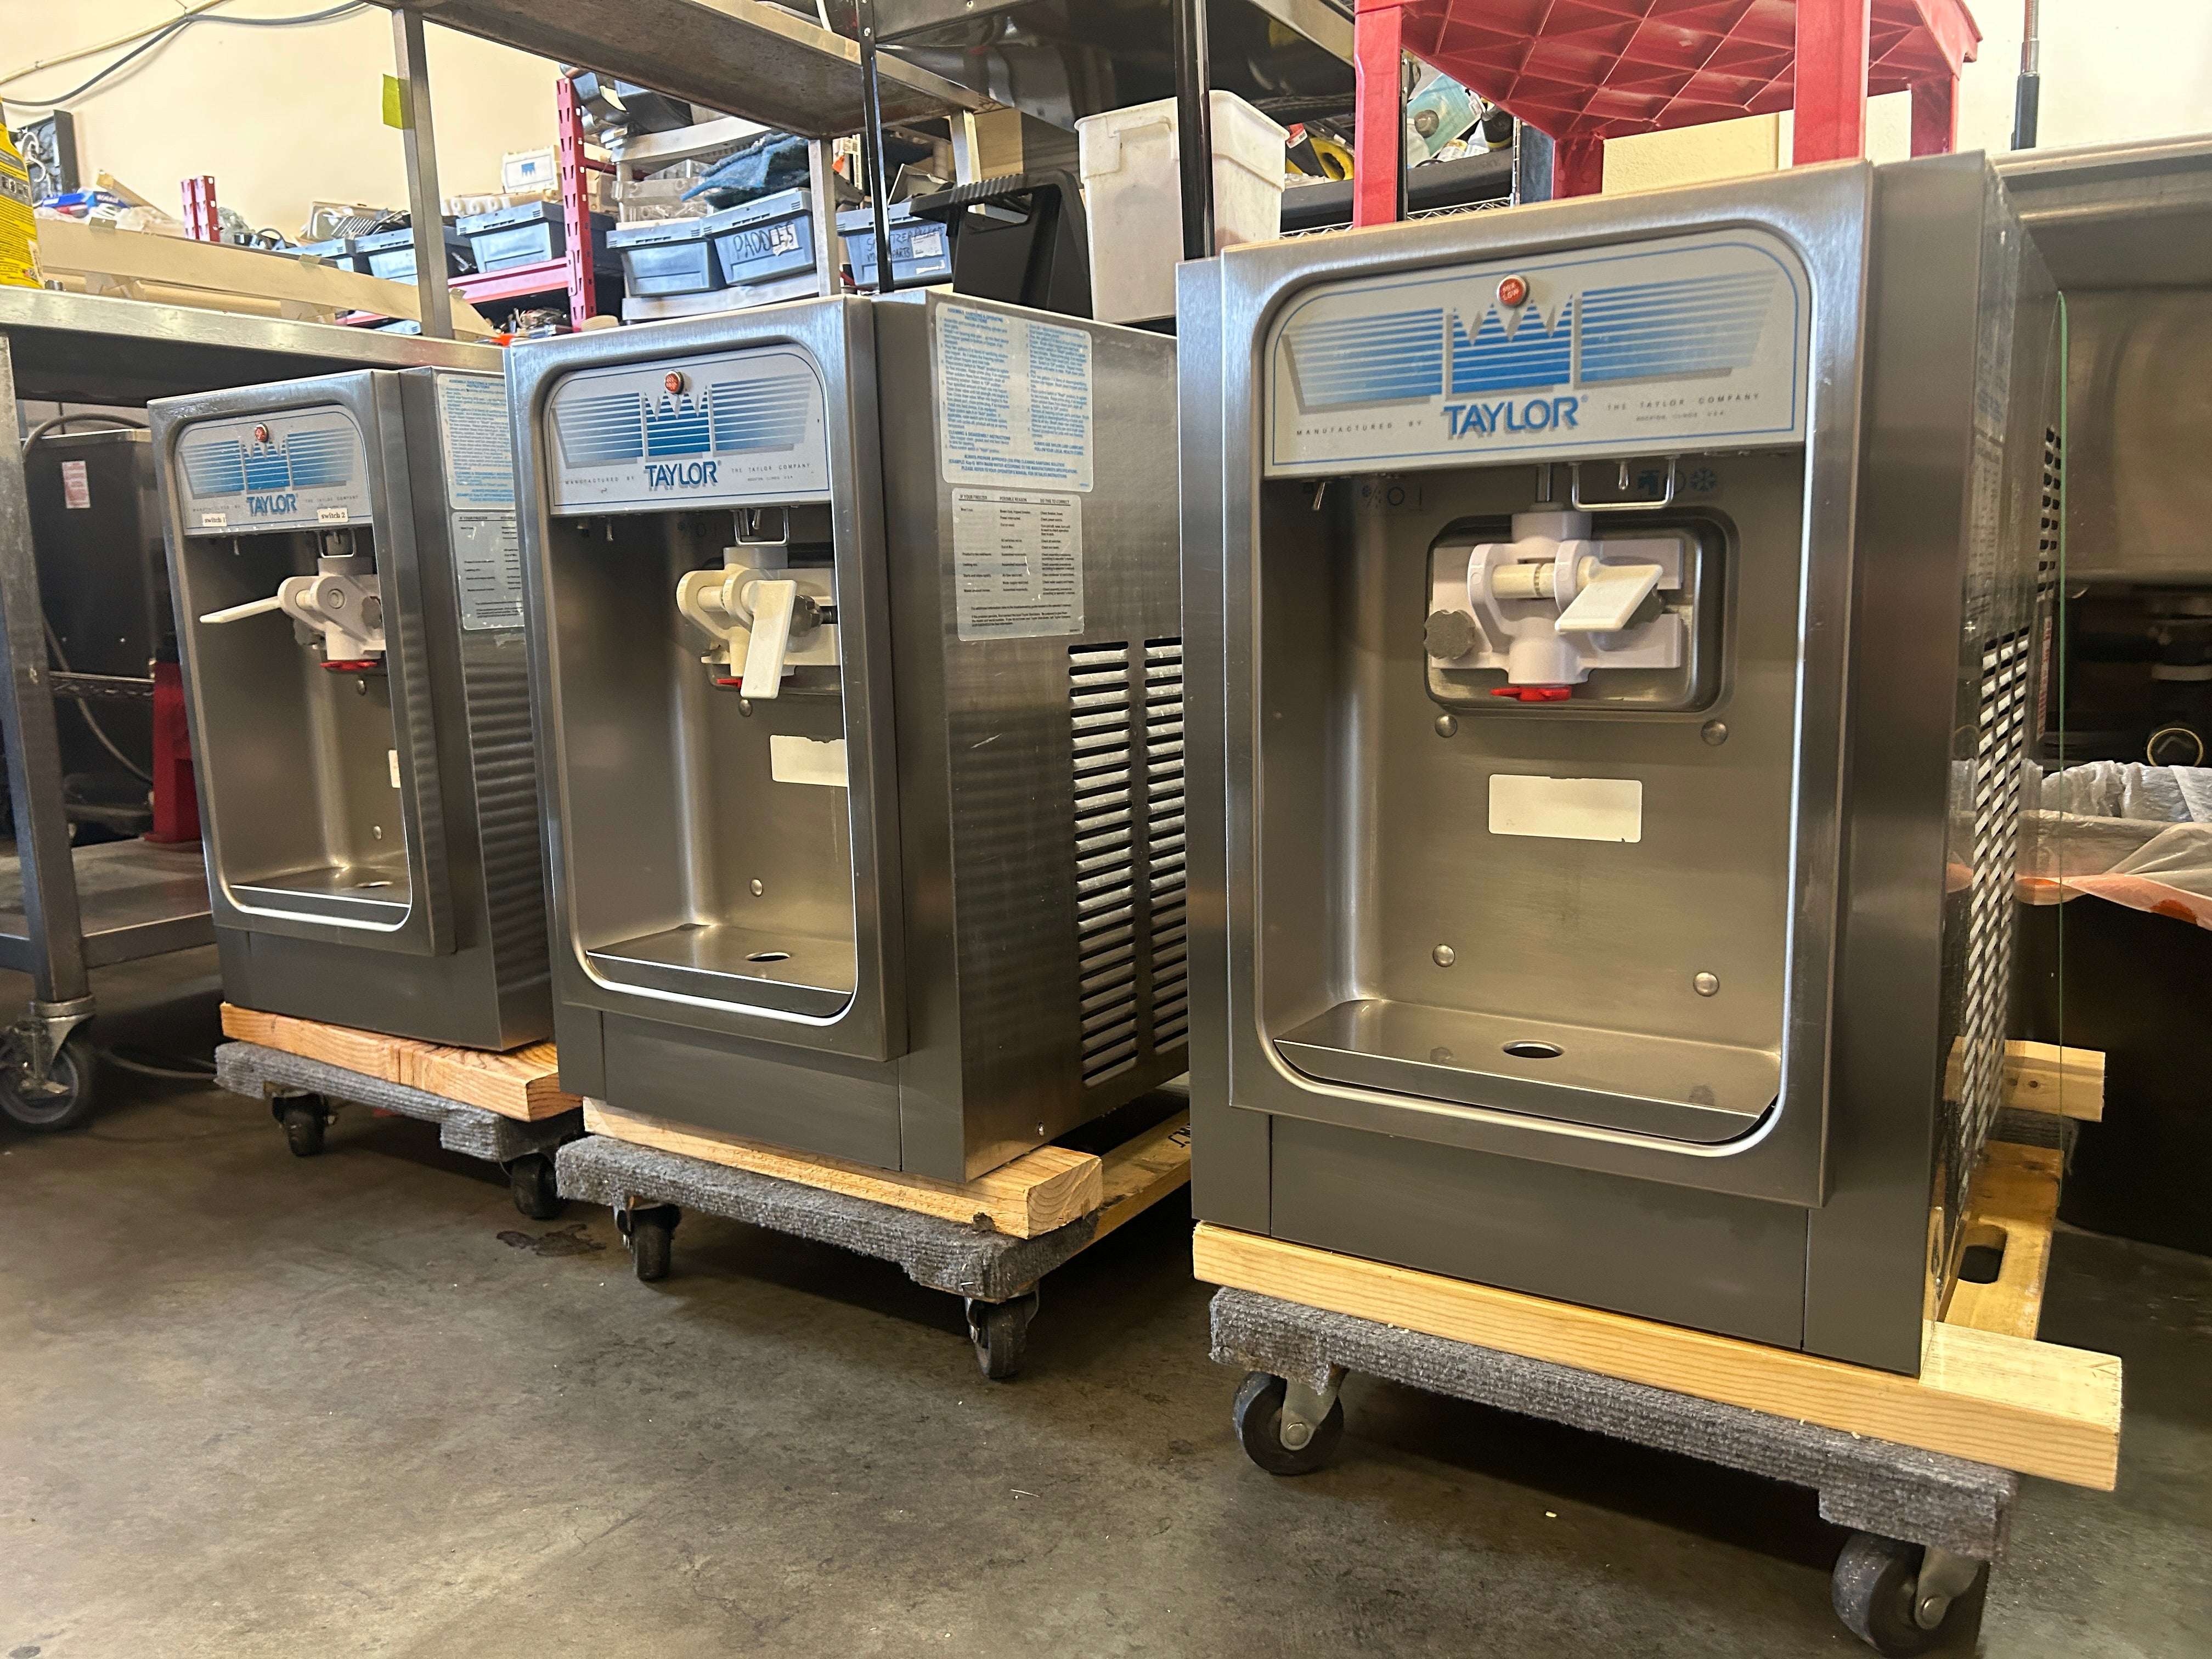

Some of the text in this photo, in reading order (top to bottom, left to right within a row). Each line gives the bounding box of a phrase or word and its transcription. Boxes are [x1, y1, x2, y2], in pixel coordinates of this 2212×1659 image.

[732, 221, 793, 260] PADDLES
[1607, 392, 1759, 410] THE TAYLOR COMPANY
[1296, 422, 1392, 436] MANUFACTURED
[1441, 396, 1579, 439] TAYLOR
[644, 461, 718, 492] TAYLOR
[246, 494, 297, 517] TAYLOR
